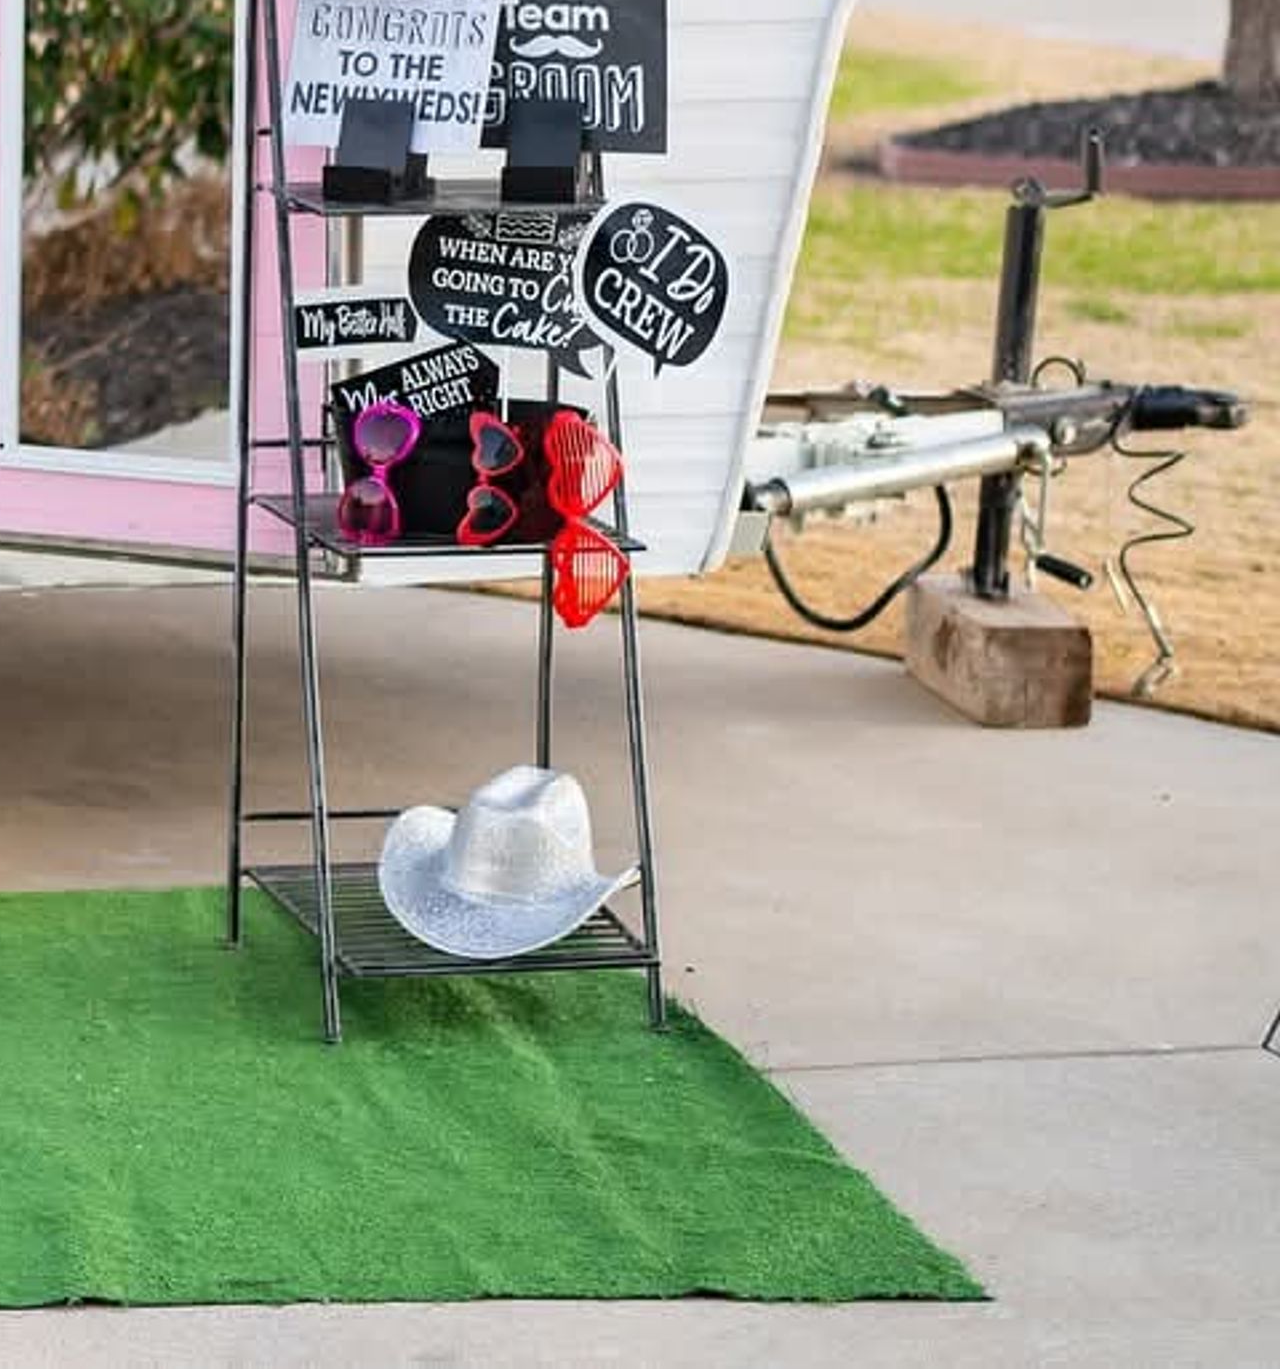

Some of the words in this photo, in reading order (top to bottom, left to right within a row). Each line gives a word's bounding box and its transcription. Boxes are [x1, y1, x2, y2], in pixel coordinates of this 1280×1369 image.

[312, 2, 487, 50] CONGRATS
[339, 50, 378, 76] TO
[391, 53, 445, 80] THE
[439, 235, 508, 266] WHEN
[509, 246, 556, 272] ARE
[638, 224, 691, 284] I
[666, 243, 716, 315] Do
[432, 266, 506, 297] GOING
[508, 276, 540, 301] TO
[542, 272, 579, 314] Cu
[594, 267, 695, 360] CREW
[301, 307, 336, 347] My
[443, 303, 490, 328] THE
[491, 301, 587, 349] Cake?
[401, 345, 480, 392] ALWAYS
[407, 376, 474, 419] RIGHT
